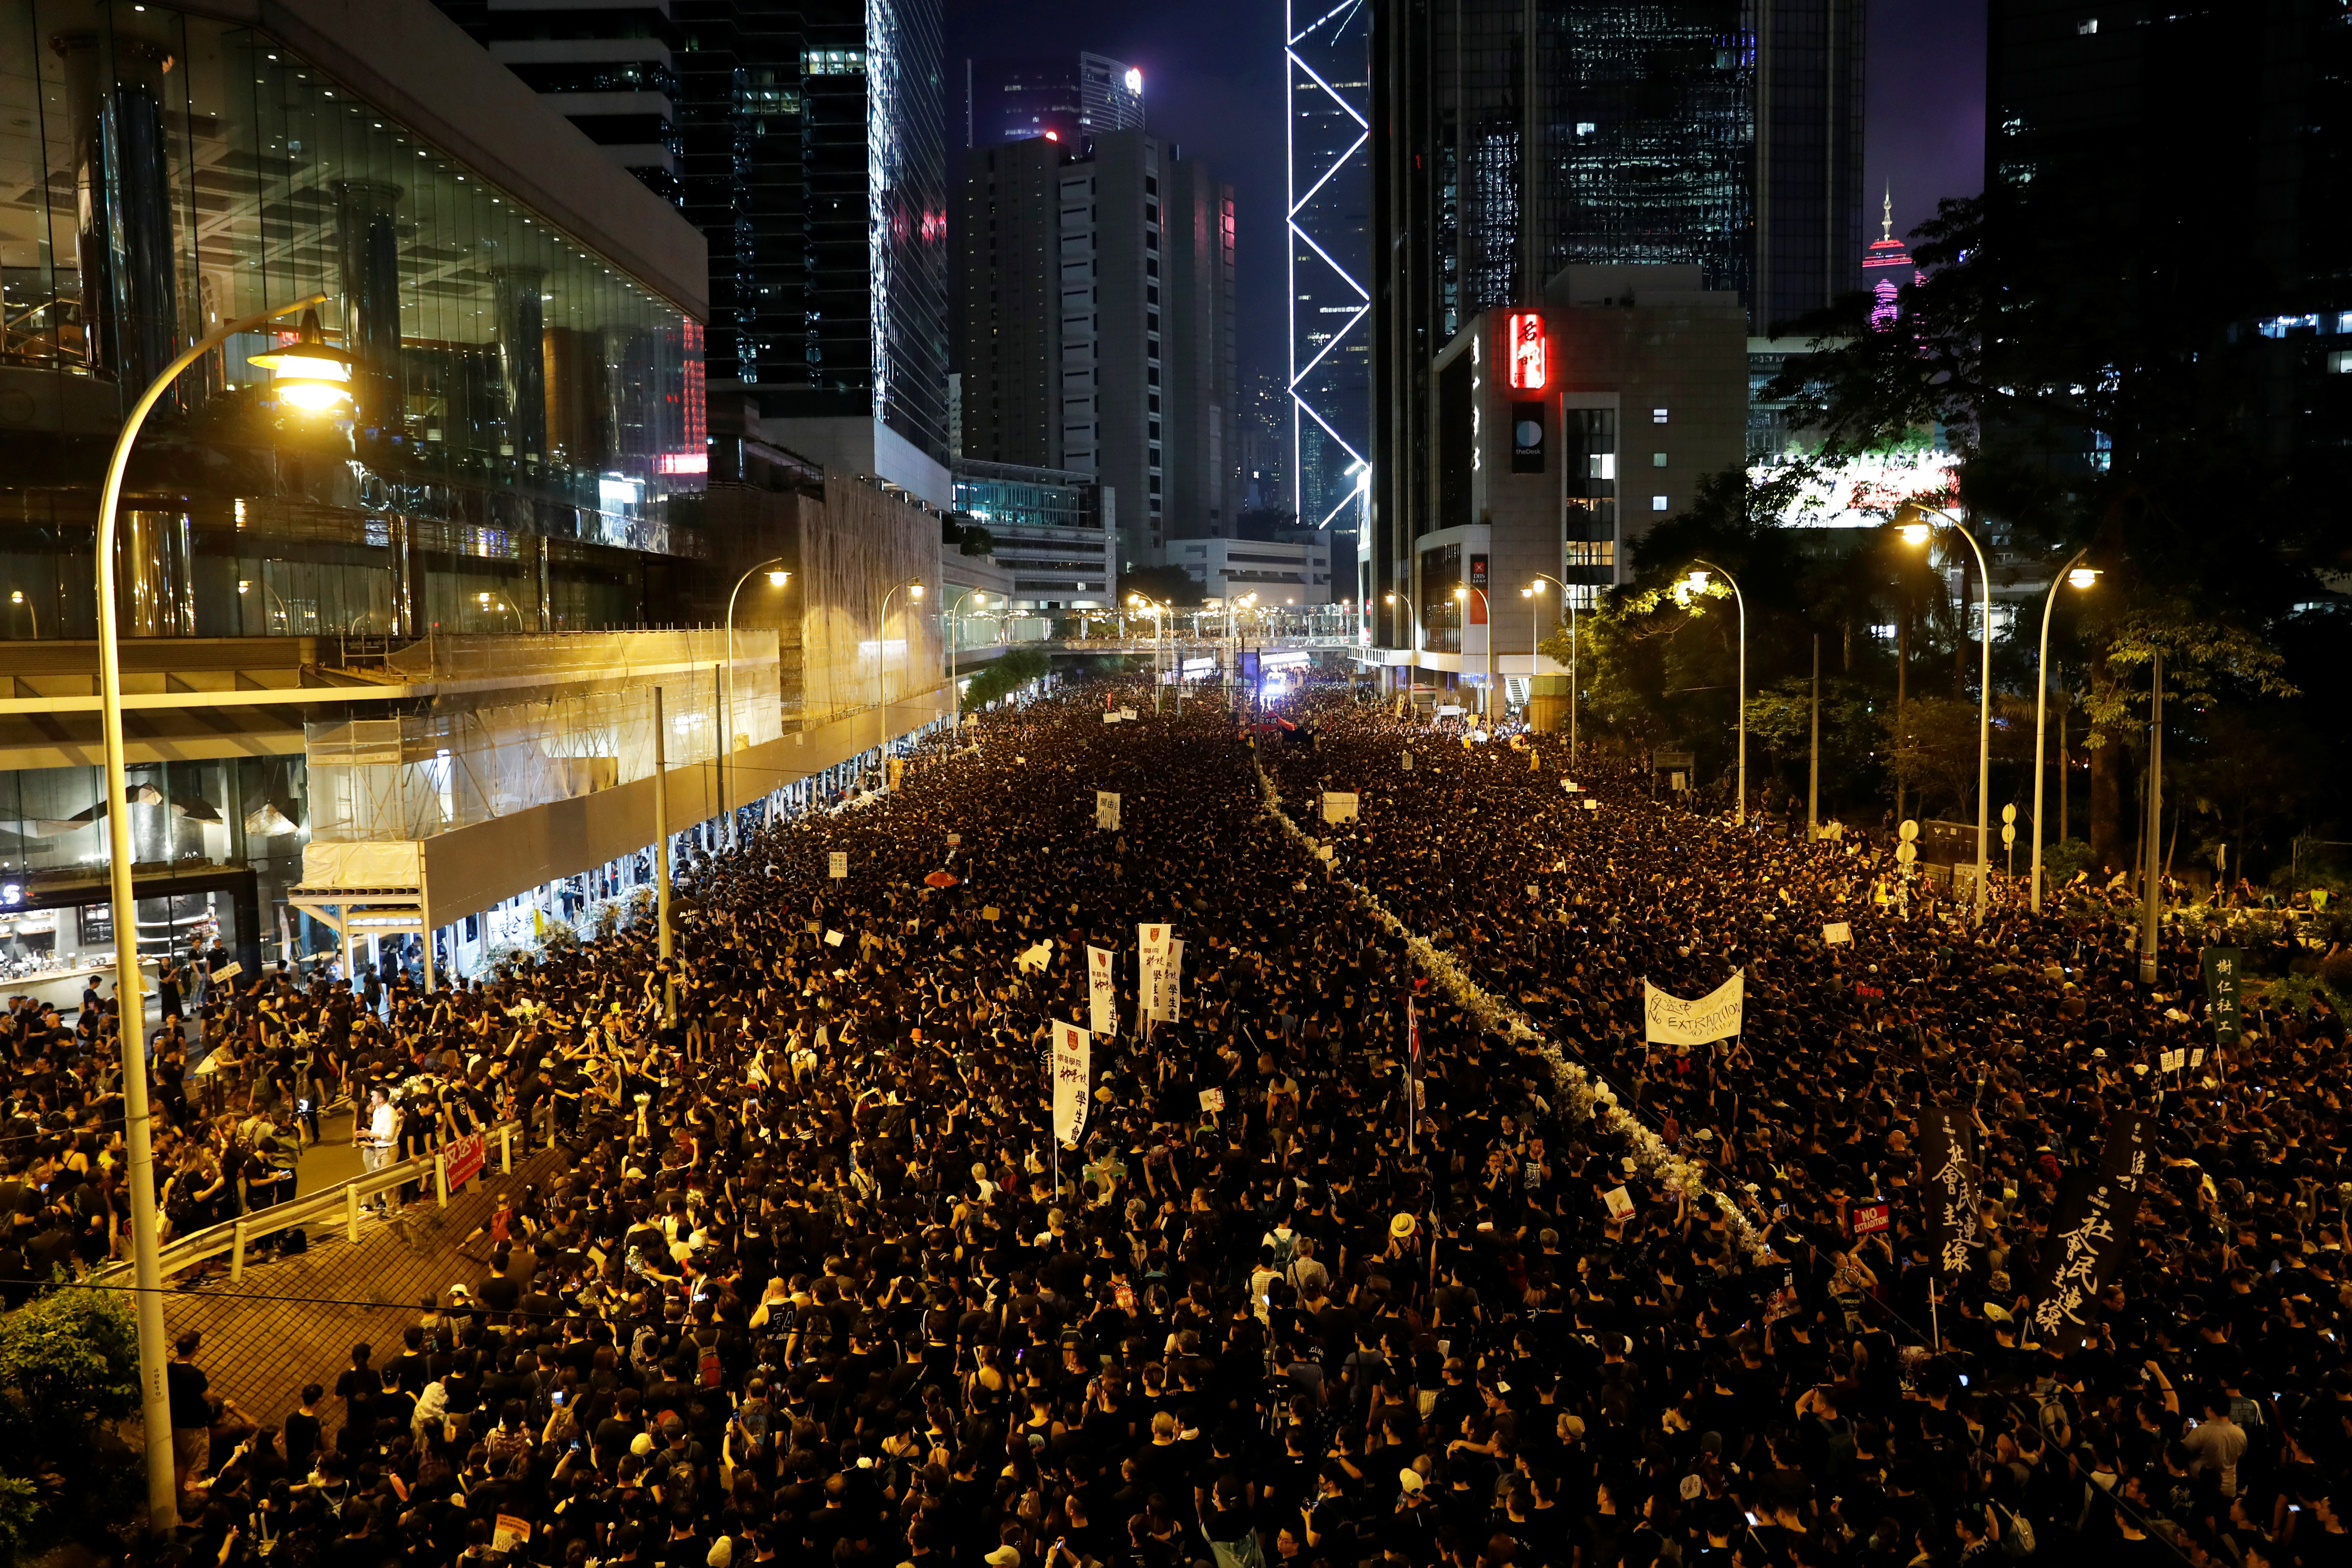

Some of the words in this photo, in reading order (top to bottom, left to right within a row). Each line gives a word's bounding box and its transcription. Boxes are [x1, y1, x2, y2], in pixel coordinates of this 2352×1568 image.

[1168, 984, 1178, 1020] 學生會
[2216, 959, 2233, 1032] 樹仁社工
[1707, 1020, 1735, 1035] CHINA
[1057, 1054, 1081, 1068] 崇基學院
[2162, 1056, 2174, 1067] 法
[2191, 1052, 2202, 1063] 抗
[459, 1103, 467, 1115] 8
[1071, 1090, 1086, 1142] 學生會
[1932, 1139, 1984, 1274] 社會民主連線
[1861, 1208, 1877, 1222] NO
[1854, 1216, 1889, 1232] EXTRADITION!
[2035, 1209, 2114, 1336] 社會民主連線
